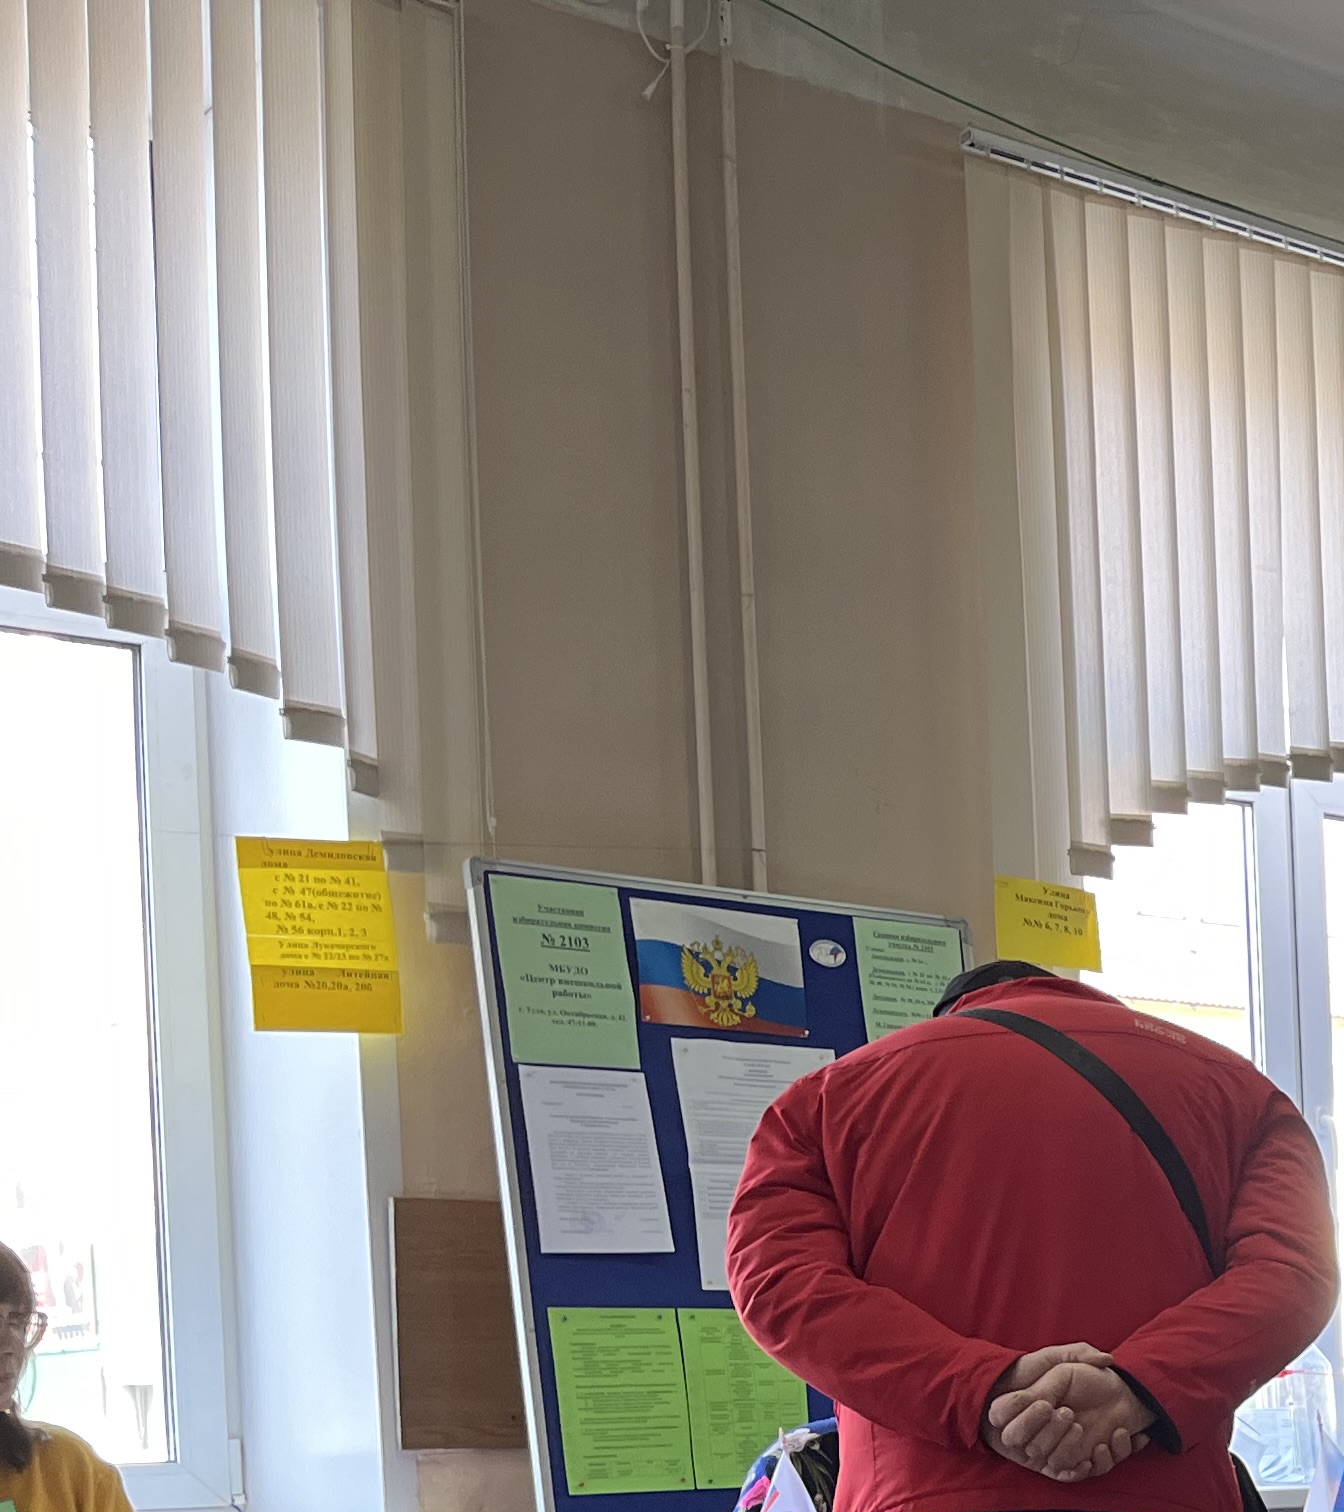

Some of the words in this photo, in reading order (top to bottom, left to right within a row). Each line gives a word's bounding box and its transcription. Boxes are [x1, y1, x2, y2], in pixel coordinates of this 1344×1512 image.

[283, 873, 296, 883] №
[330, 875, 342, 886] №
[283, 886, 296, 896] №
[1043, 887, 1071, 899] Улица
[280, 899, 293, 909] №
[326, 901, 339, 911] №
[370, 903, 383, 913] №
[284, 911, 297, 922] №
[276, 924, 289, 935] №
[541, 933, 556, 947] №
[559, 934, 590, 949] 2103
